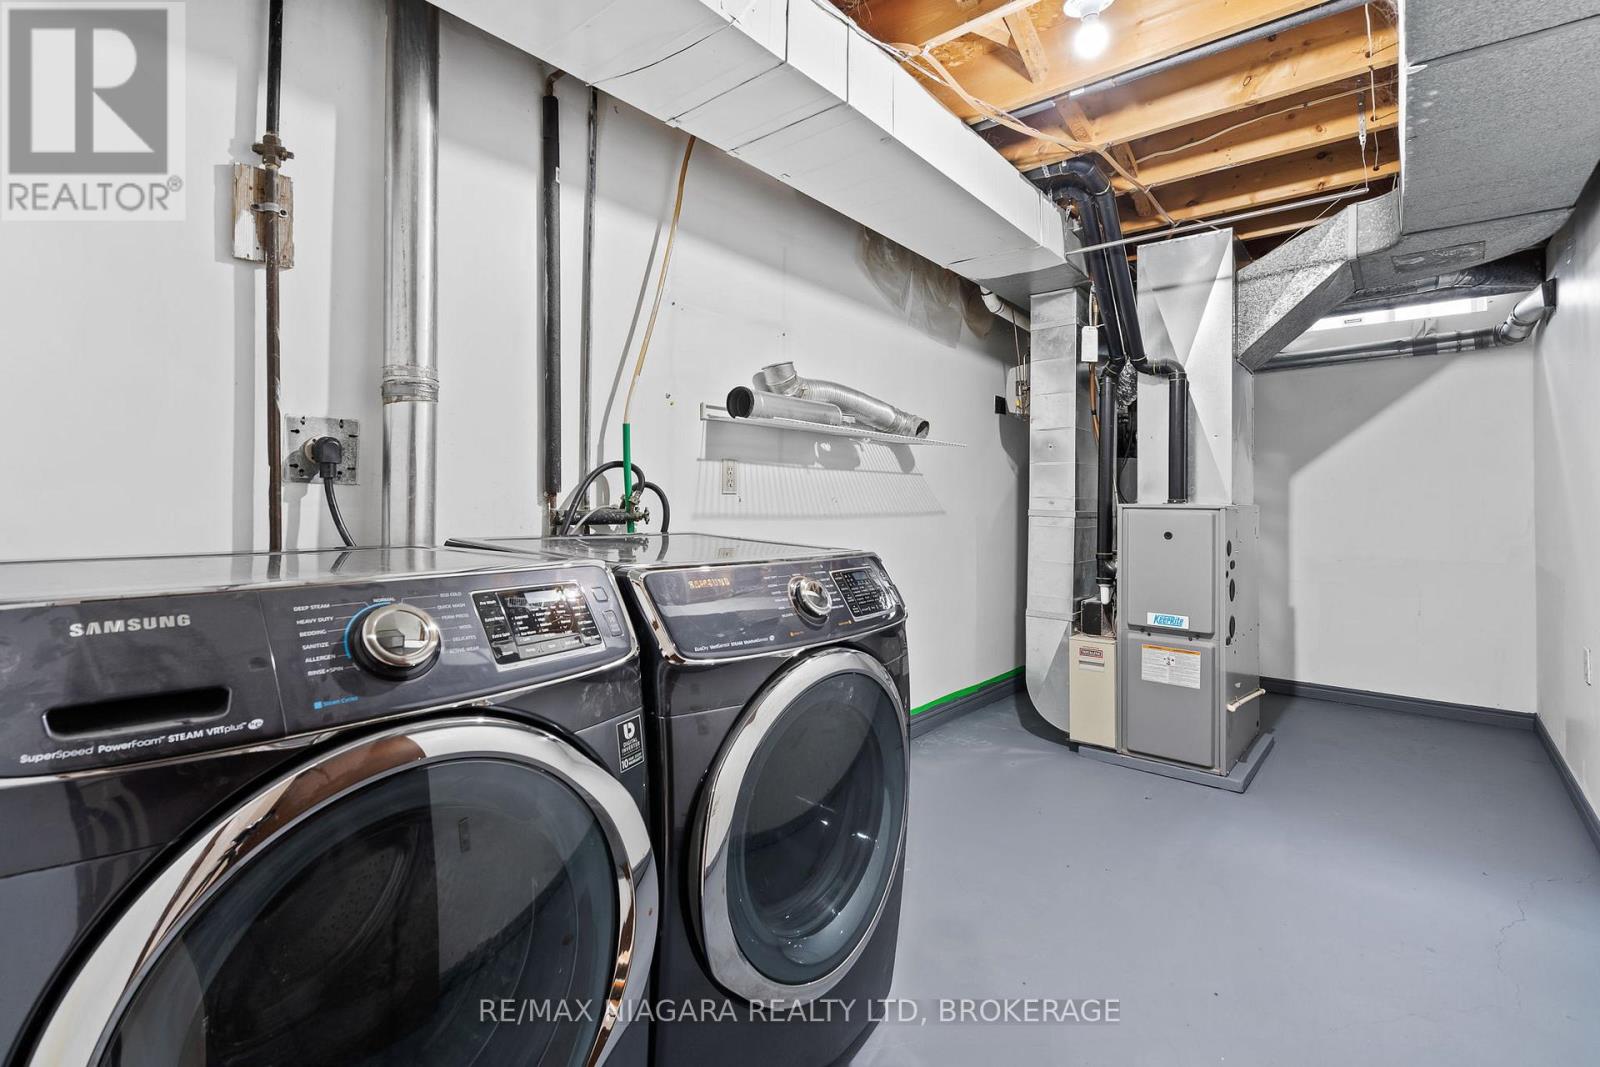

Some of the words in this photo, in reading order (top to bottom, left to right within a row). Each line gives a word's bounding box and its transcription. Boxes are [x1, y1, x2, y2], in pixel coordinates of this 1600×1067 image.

[69, 614, 192, 637] SAMSUNG
[19, 745, 95, 764] SuperSpeed
[167, 730, 204, 743] STEAM
